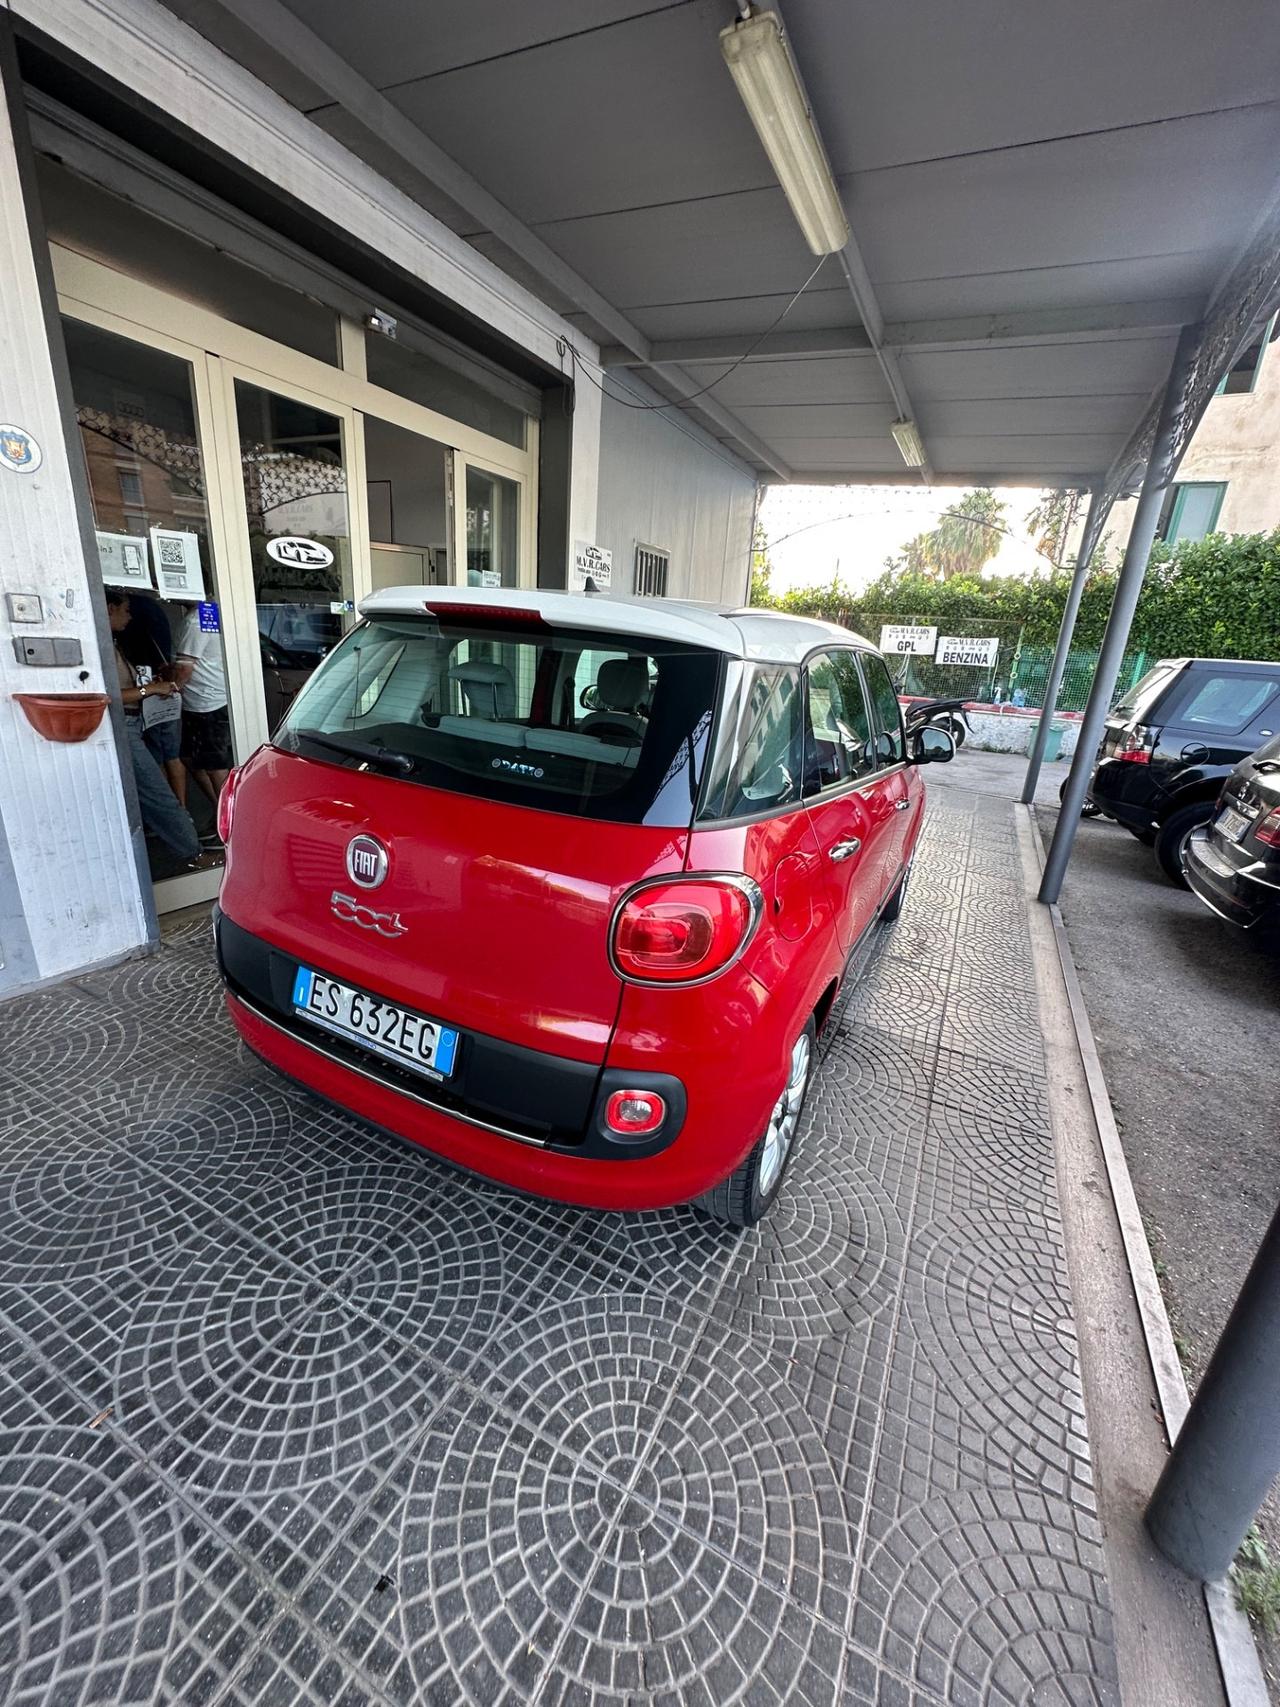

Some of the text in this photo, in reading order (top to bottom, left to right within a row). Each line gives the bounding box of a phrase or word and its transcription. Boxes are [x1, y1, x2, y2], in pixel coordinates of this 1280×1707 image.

[897, 640, 917, 652] GPL
[942, 651, 989, 665] BENZINA
[353, 848, 378, 878] FIAT
[309, 974, 436, 1060] ES 632EG
